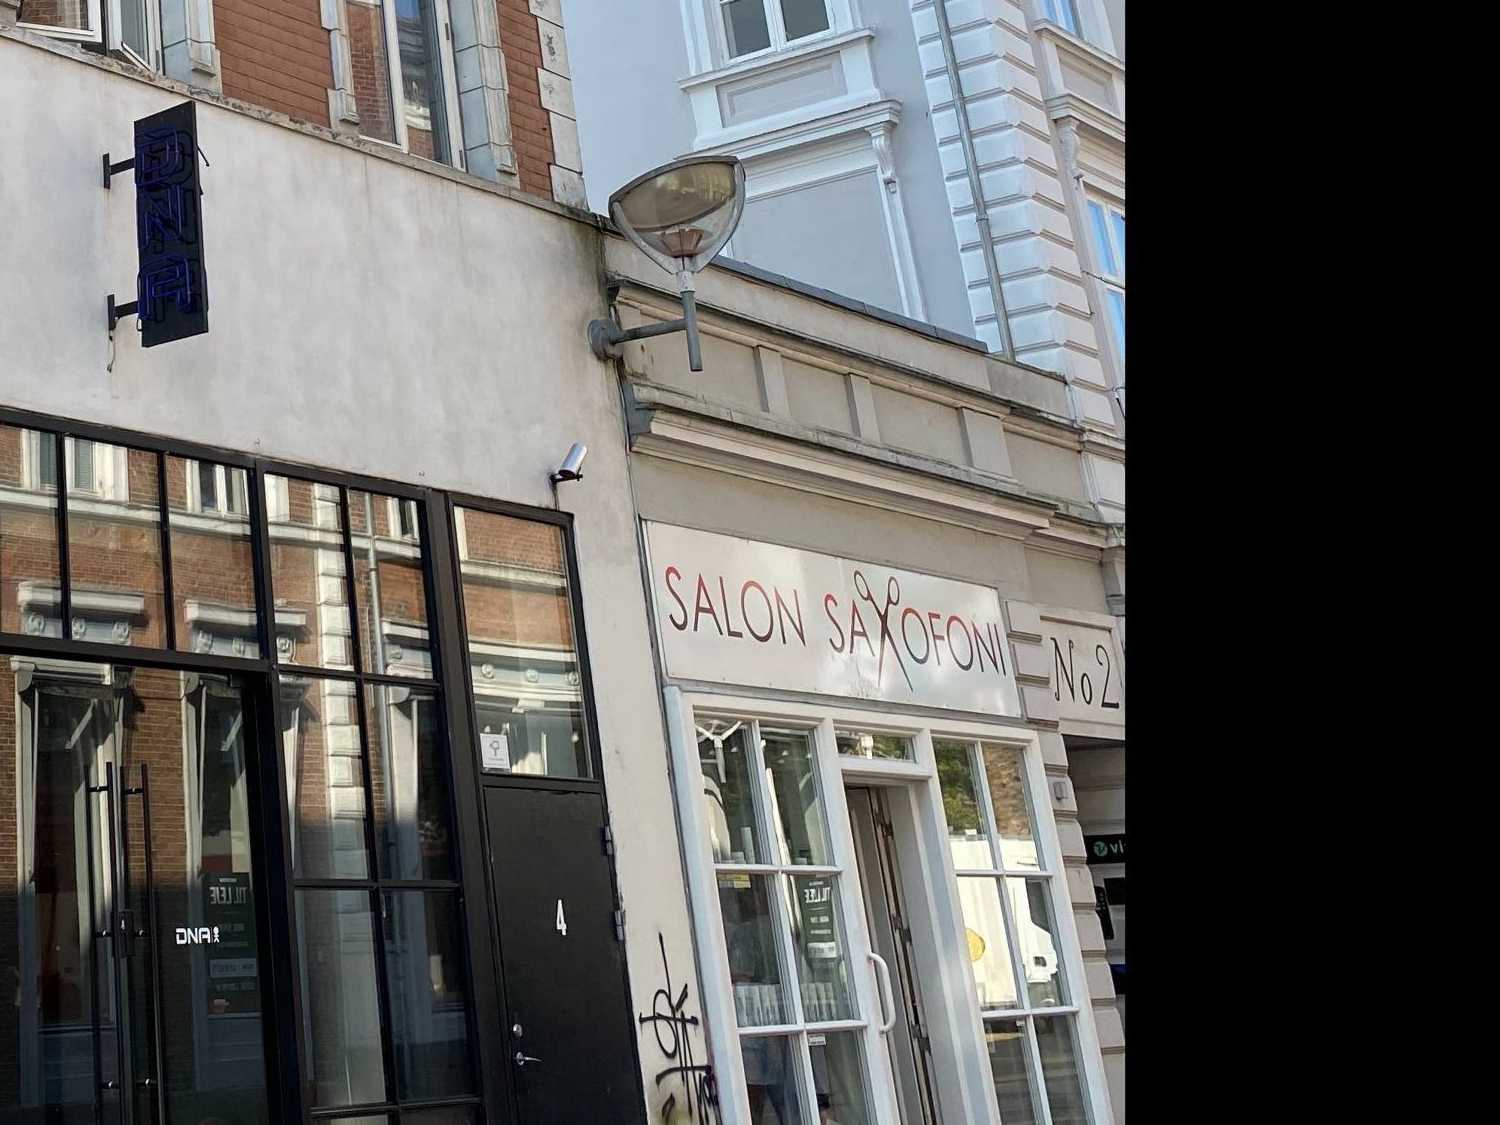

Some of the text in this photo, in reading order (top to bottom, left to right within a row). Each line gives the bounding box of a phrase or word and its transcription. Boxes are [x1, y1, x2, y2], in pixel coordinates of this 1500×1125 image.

[664, 566, 807, 647] SALON
[175, 927, 211, 944] DNA
[556, 899, 567, 936] 4
